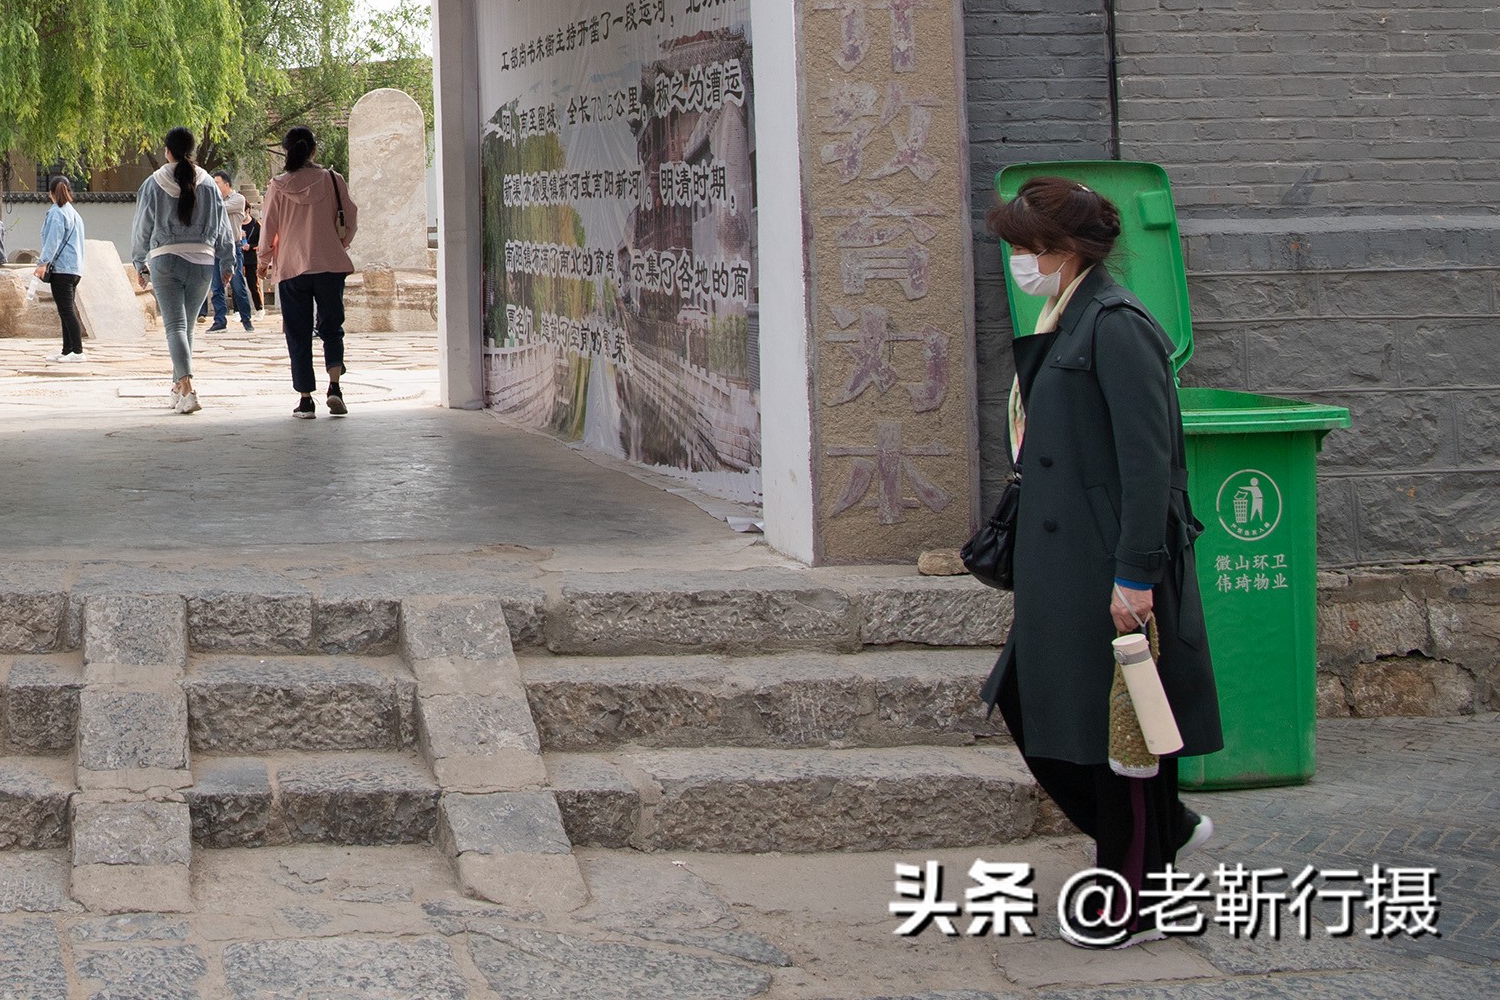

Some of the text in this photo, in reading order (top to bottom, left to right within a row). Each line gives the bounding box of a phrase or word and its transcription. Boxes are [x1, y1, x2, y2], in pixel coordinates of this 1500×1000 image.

[1214, 554, 1288, 571] 微山环卫
[1215, 573, 1288, 592] 伟琦物业
